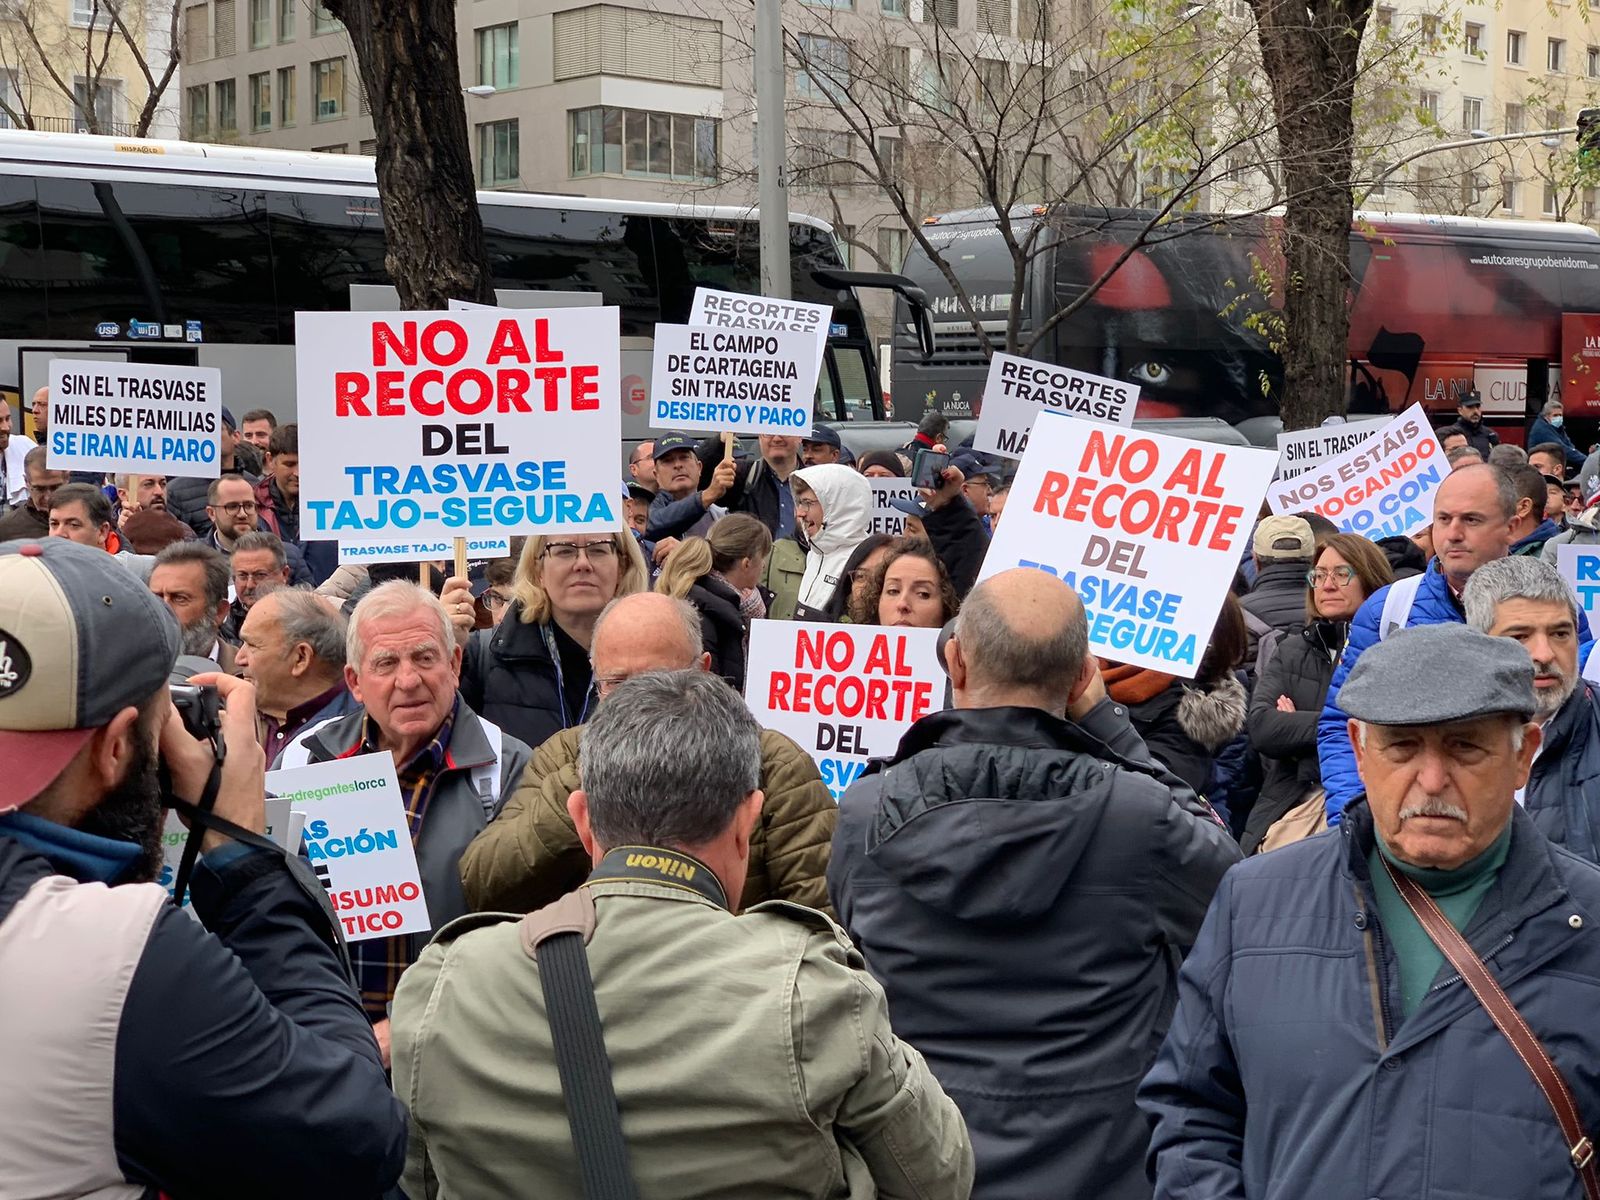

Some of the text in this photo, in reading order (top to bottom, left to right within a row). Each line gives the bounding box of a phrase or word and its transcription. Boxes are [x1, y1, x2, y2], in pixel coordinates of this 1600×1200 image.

[704, 295, 820, 323] RECORTES
[99, 326, 119, 335] USB
[372, 318, 563, 366] NO AL
[690, 332, 778, 355] EL CAMPO
[667, 354, 798, 380] DE CARTAGENA
[1001, 361, 1127, 404] RECORTES
[62, 374, 206, 402] SIN EL TRASVASE
[335, 366, 600, 417] RECORTE
[671, 378, 791, 402] SIN TRASVASE
[1001, 379, 1122, 422] TRASVASE
[1425, 378, 1446, 400] LA
[54, 404, 216, 433] MILES DE FAMILIAS
[657, 400, 806, 427] DESIERTO Y PARO
[53, 431, 216, 463] SE IRAN AL PARO
[422, 423, 509, 457] DEL
[1287, 442, 1306, 461] SIN
[1309, 440, 1322, 458] EL
[345, 461, 566, 496] TRASVASE
[1078, 430, 1226, 498] NO AL
[1279, 420, 1420, 510] NOS ESTÁIS
[1379, 465, 1441, 515] CON
[307, 493, 614, 530] TAJO-SEGURA
[1033, 471, 1244, 551] RECORTE
[341, 540, 507, 556] TRASVASE TAJO-GURA
[1081, 535, 1148, 579] DEL
[795, 629, 912, 676] NO AL
[768, 671, 932, 722] RECORTE
[816, 722, 869, 755] DEL
[626, 854, 695, 880] Nikon
